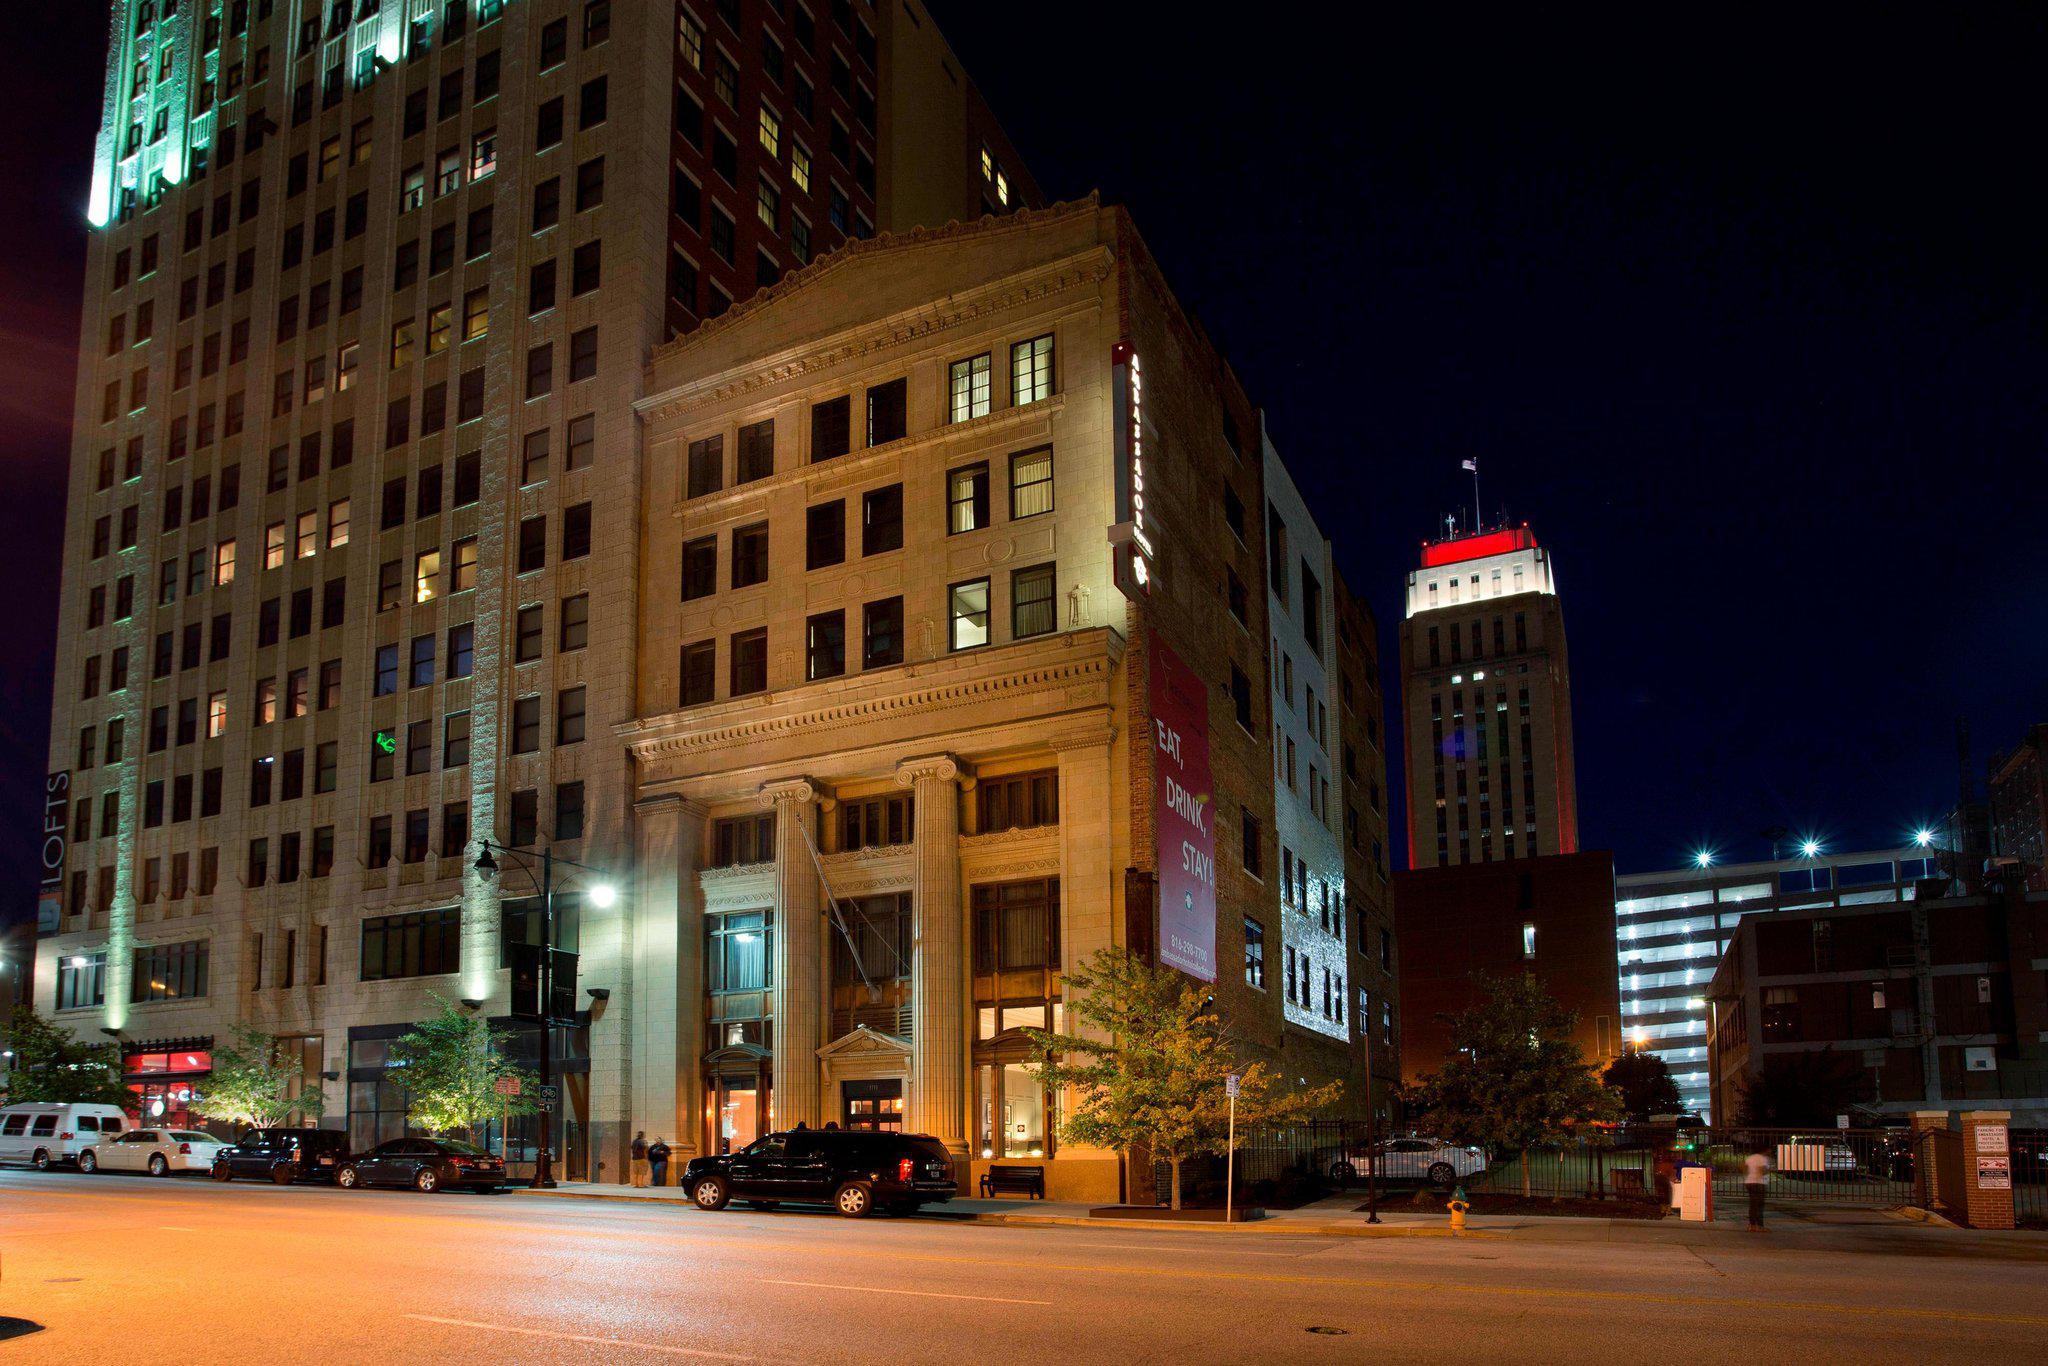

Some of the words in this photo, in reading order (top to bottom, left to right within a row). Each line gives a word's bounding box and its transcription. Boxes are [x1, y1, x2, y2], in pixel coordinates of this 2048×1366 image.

[1155, 717, 1184, 769] EAT,
[42, 773, 69, 885] LOFTS
[1165, 777, 1207, 838] DRINK,
[1182, 840, 1215, 886] STAY!
